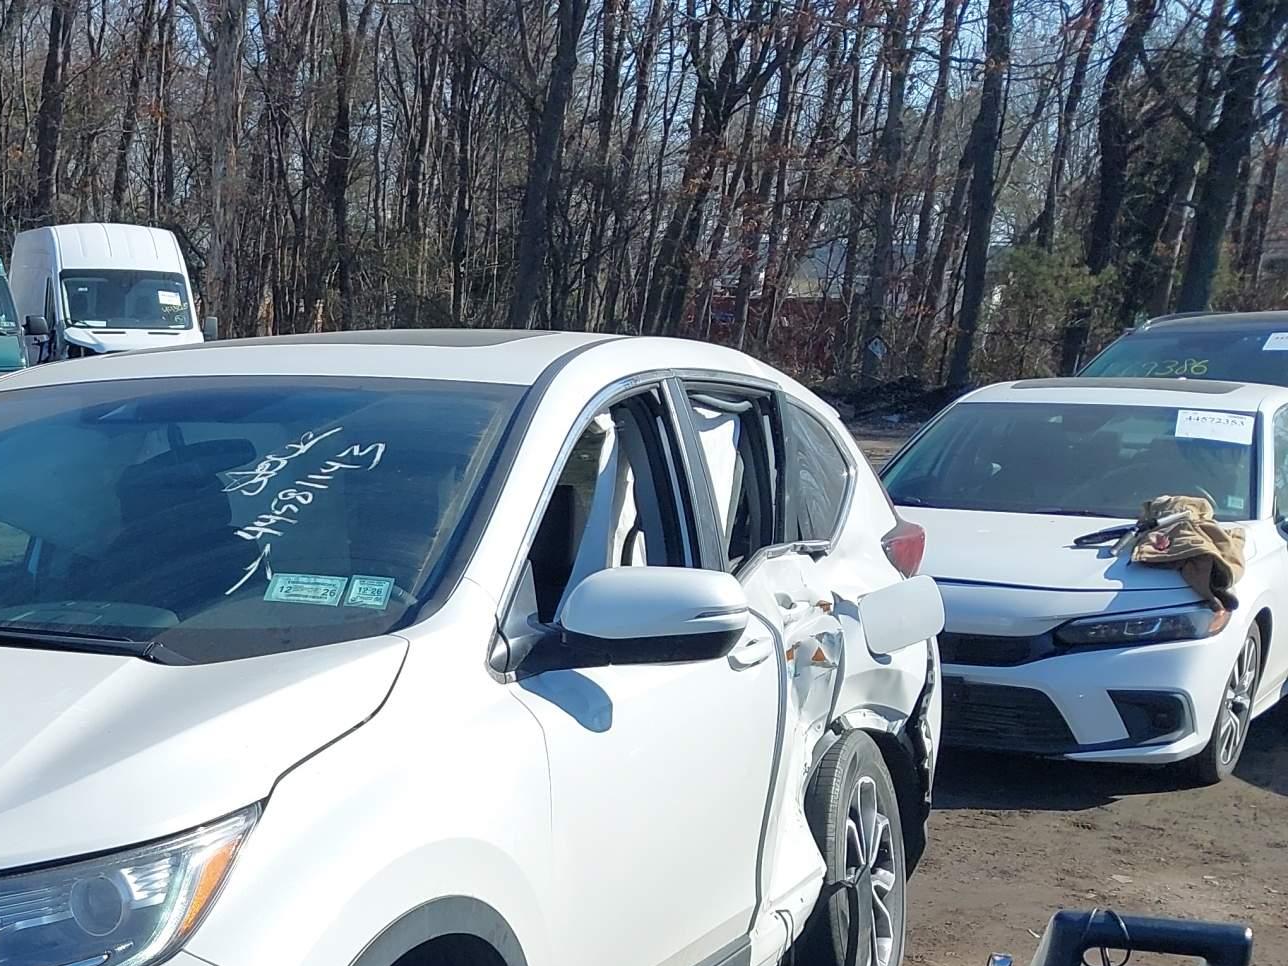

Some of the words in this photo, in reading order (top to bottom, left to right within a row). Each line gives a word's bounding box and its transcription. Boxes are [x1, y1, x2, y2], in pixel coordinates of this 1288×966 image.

[233, 443, 386, 540] 44581143
[279, 585, 292, 594] 12
[321, 588, 336, 598] 26
